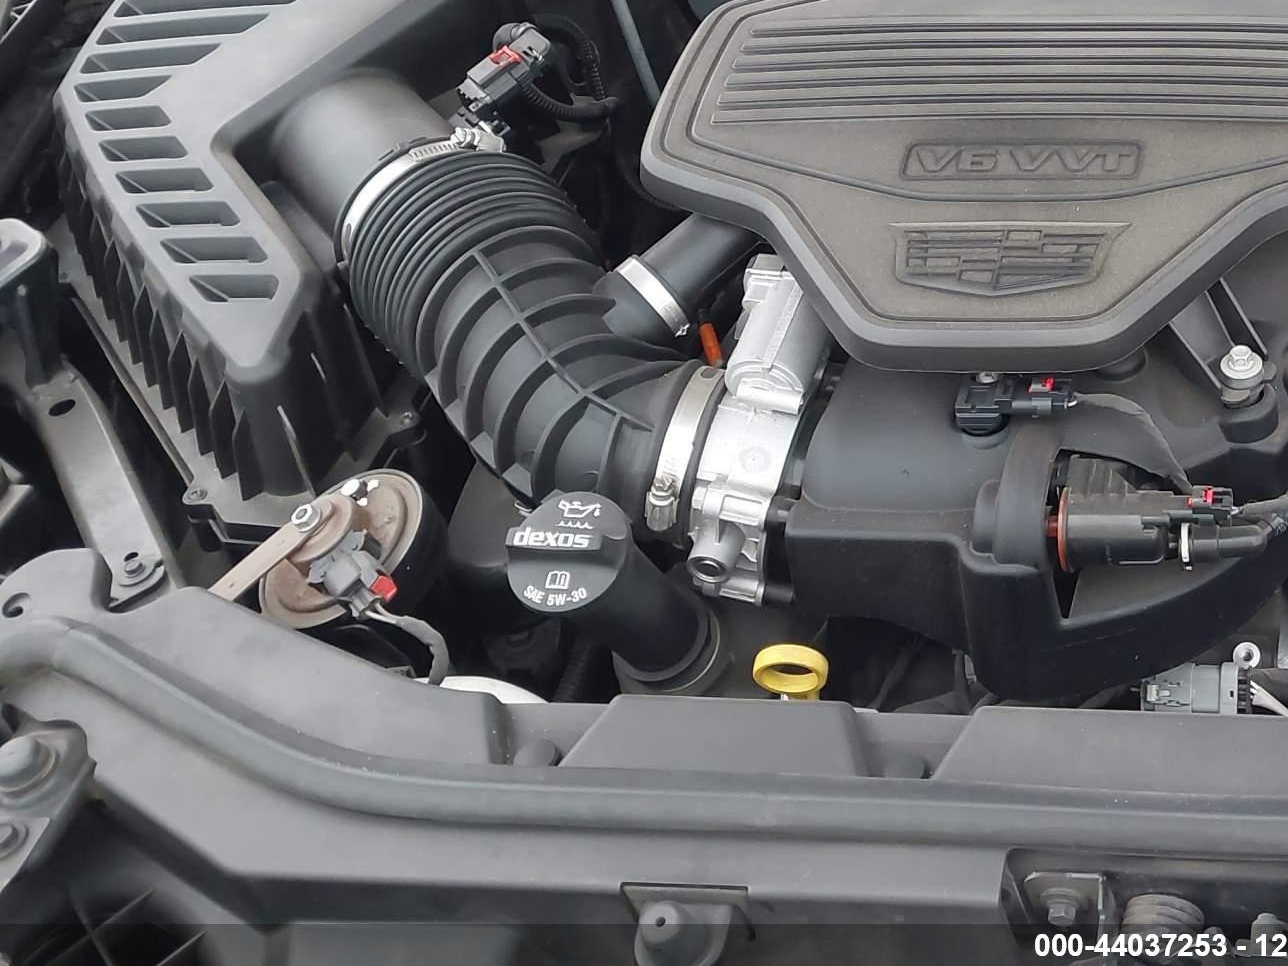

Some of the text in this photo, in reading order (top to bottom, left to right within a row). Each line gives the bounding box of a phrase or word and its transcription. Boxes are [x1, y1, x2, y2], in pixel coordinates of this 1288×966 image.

[914, 146, 1134, 173] V6 VVT
[513, 527, 593, 548] dexos
[523, 585, 587, 606] SAE 5W-30
